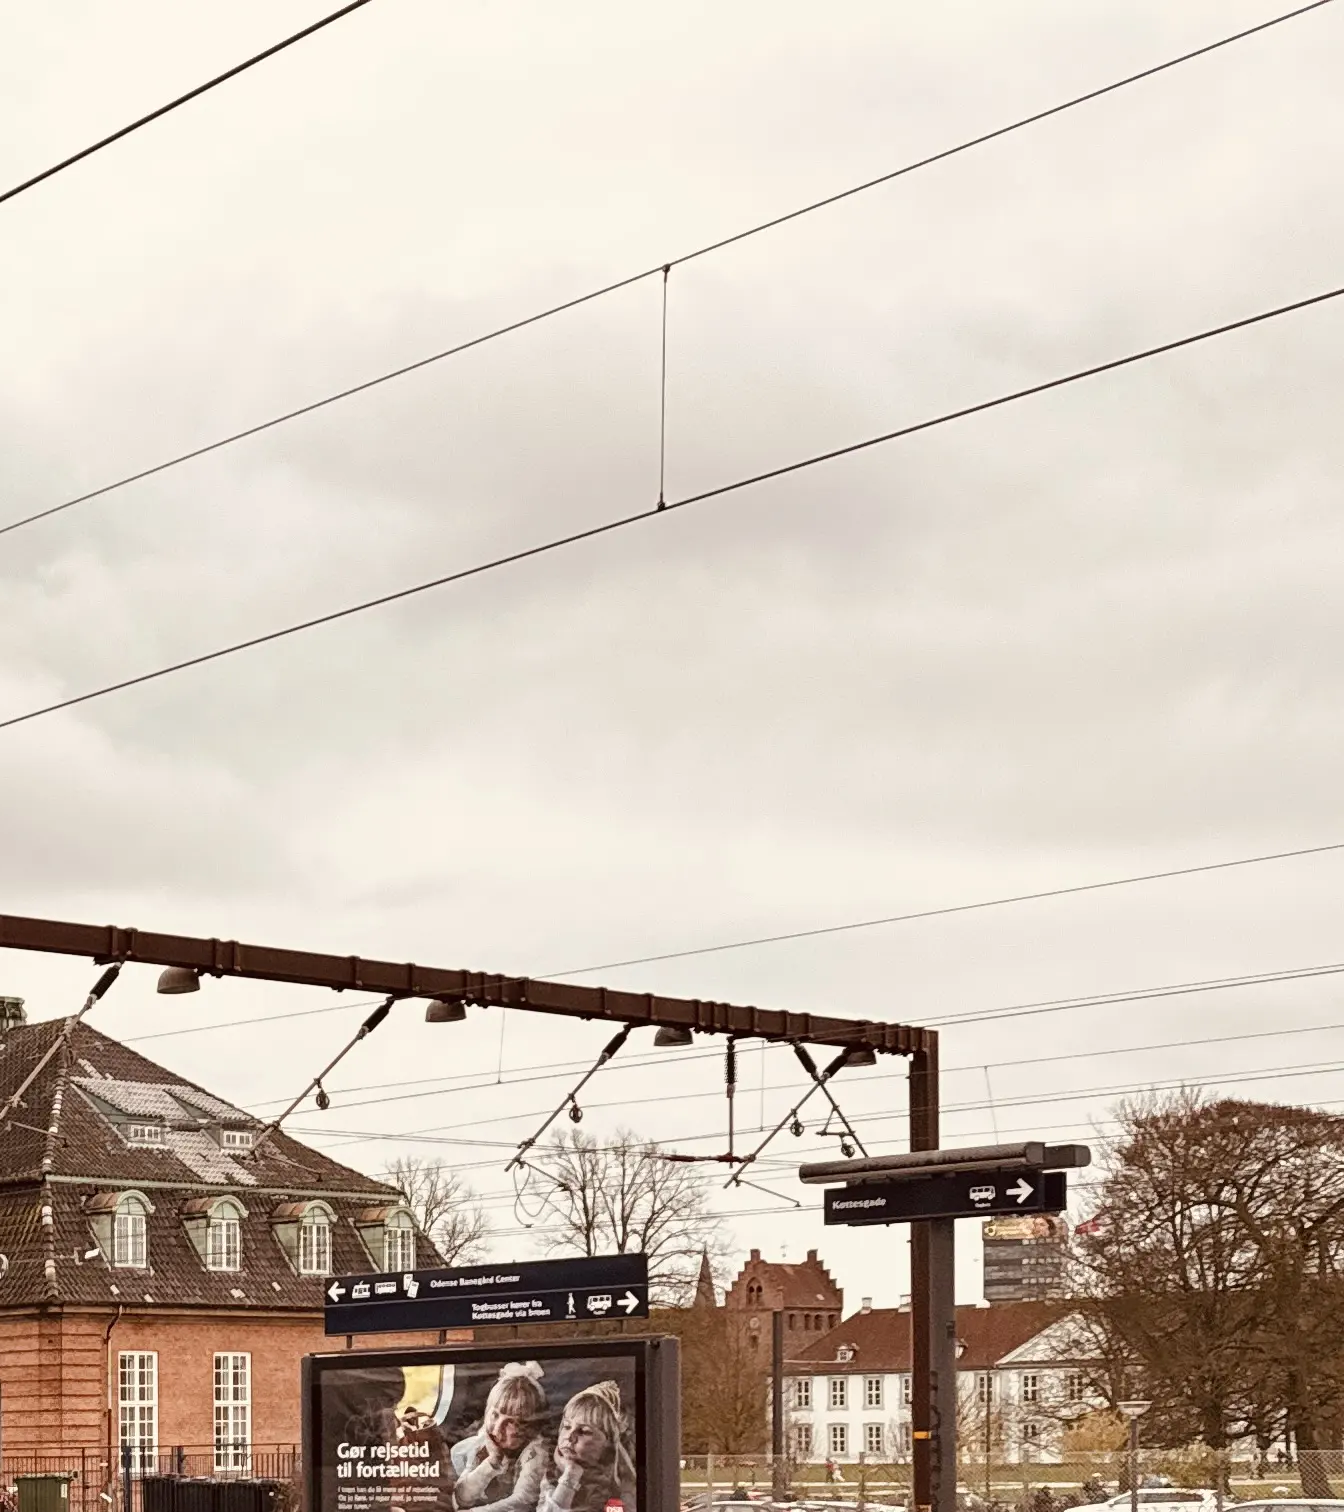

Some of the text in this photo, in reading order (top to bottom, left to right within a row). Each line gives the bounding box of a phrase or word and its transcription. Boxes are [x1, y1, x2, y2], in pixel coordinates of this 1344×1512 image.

[337, 1441, 430, 1461] Gør rejsetid
[337, 1461, 440, 1478] til fortælletid
